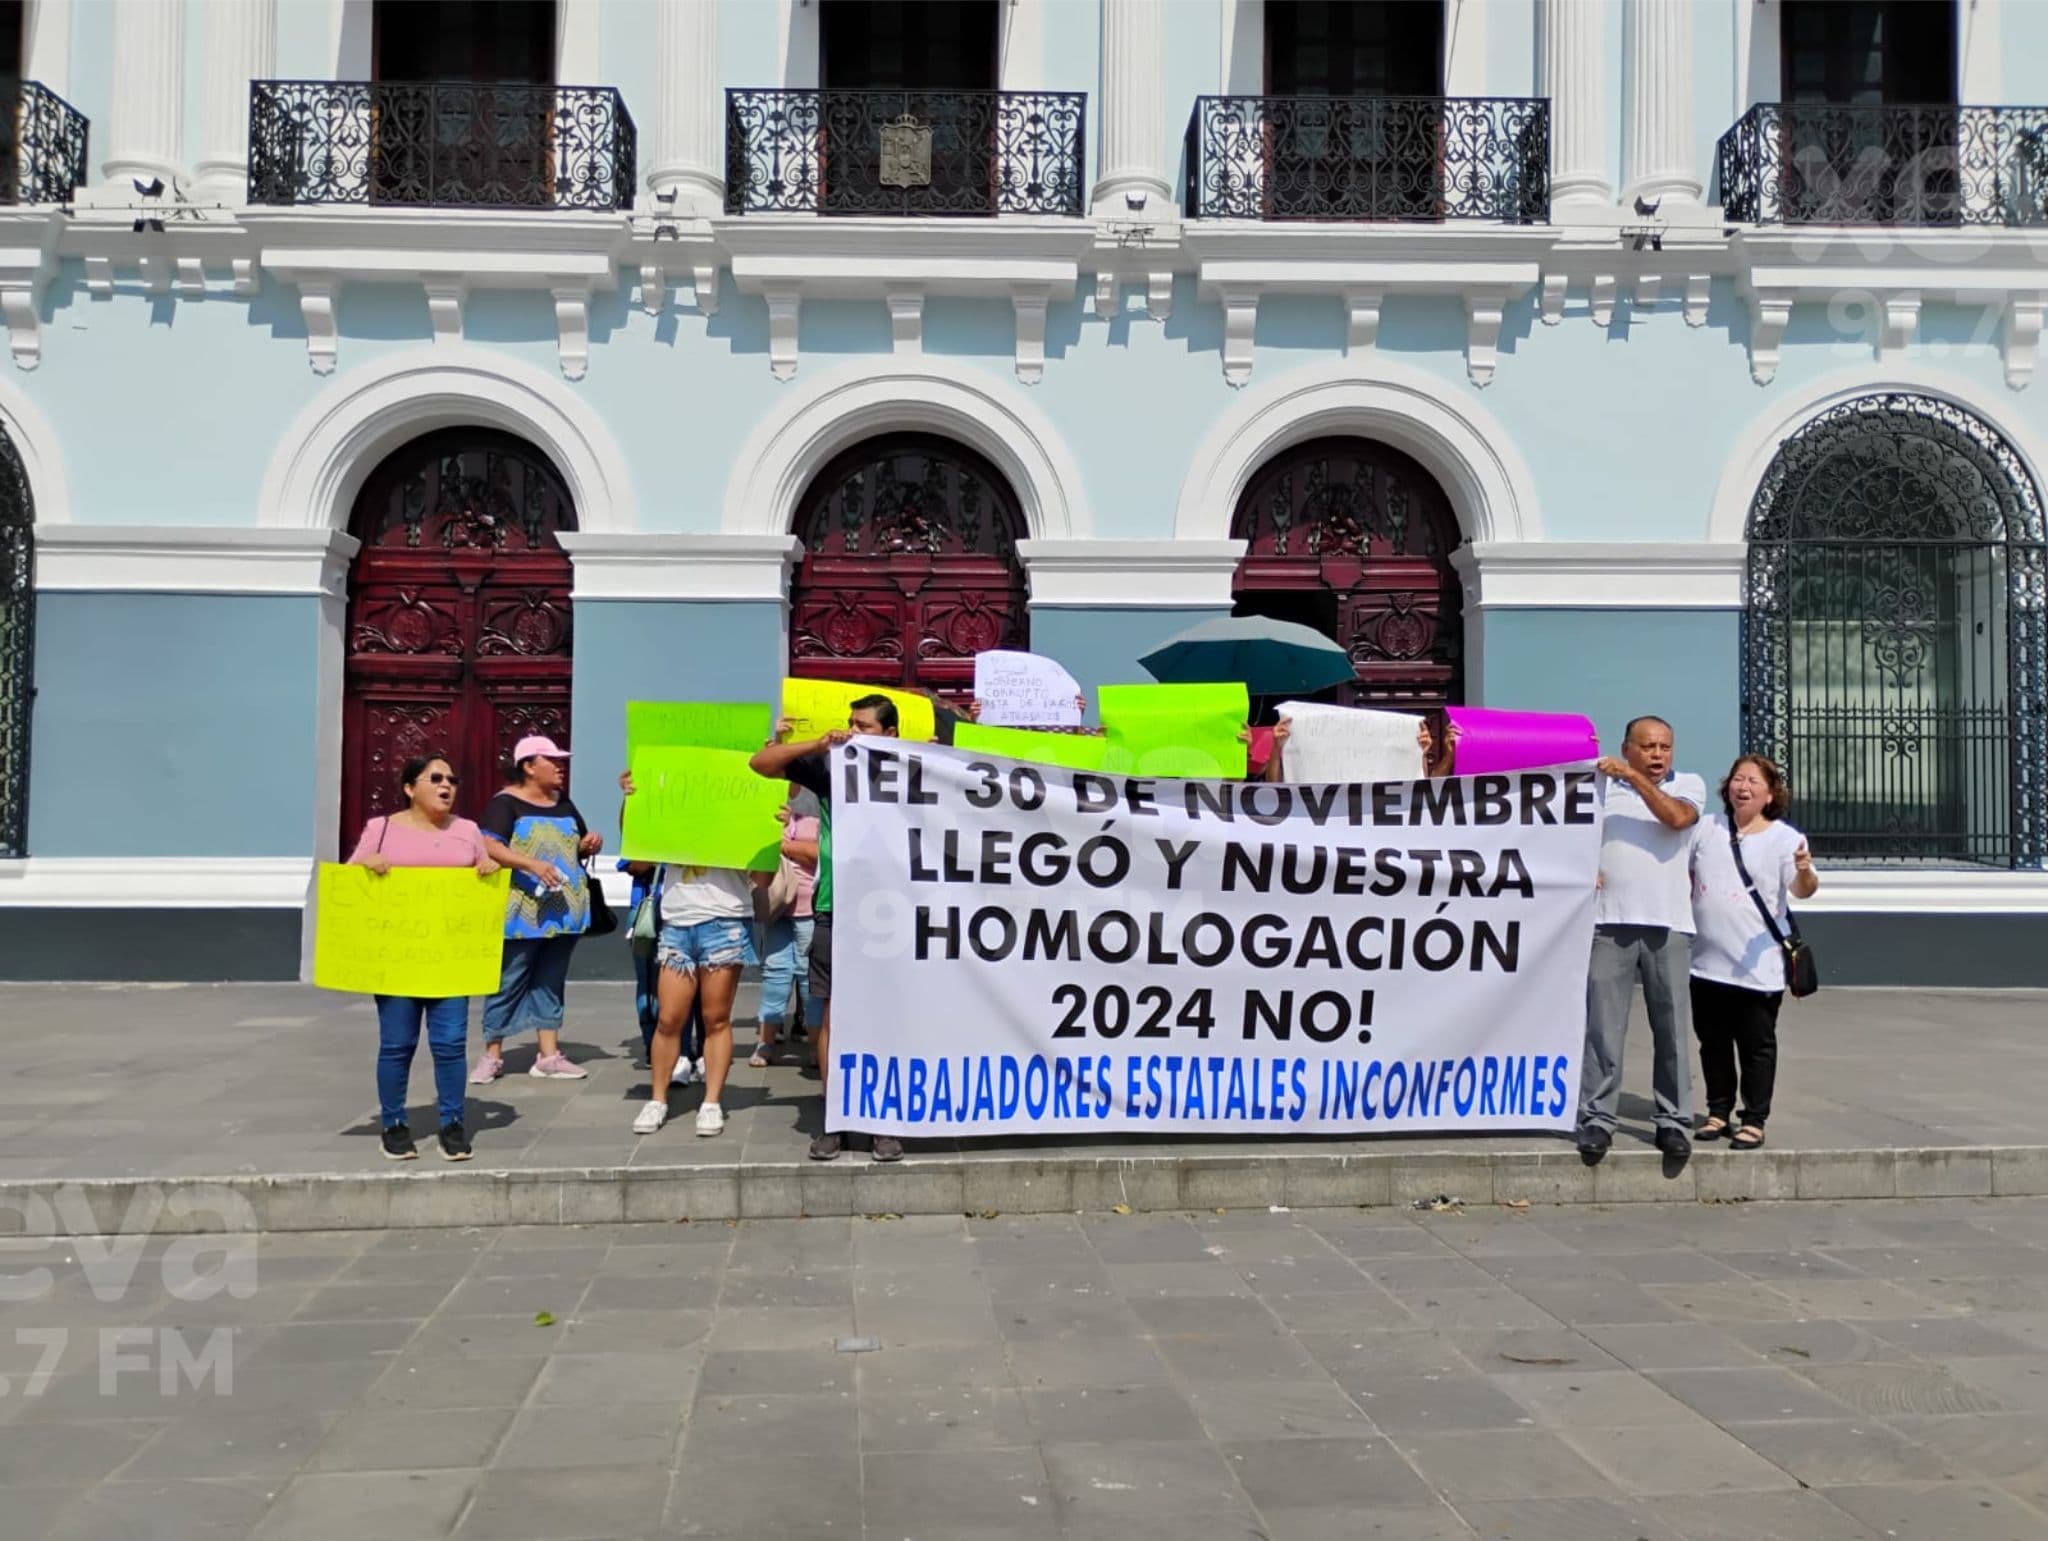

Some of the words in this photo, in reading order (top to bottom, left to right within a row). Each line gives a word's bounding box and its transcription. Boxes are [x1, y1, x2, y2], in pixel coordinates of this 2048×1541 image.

[844, 745, 938, 805] ¡EL
[965, 762, 1046, 811] 30
[1072, 773, 1160, 816] DE
[1184, 772, 1596, 826] NOVIEMBRE
[908, 818, 1131, 888] LLEGÓ
[1155, 839, 1200, 890] Y
[1221, 842, 1534, 898] NUESTRA
[915, 902, 1520, 973] HOMOLOGACIÓN
[1053, 984, 1215, 1039] 2024
[1243, 989, 1375, 1044] NO!
[839, 1053, 1112, 1123] TRABAJADORES
[1126, 1055, 1307, 1121] ESTATALES
[1320, 1056, 1568, 1121] INCONFORMES
